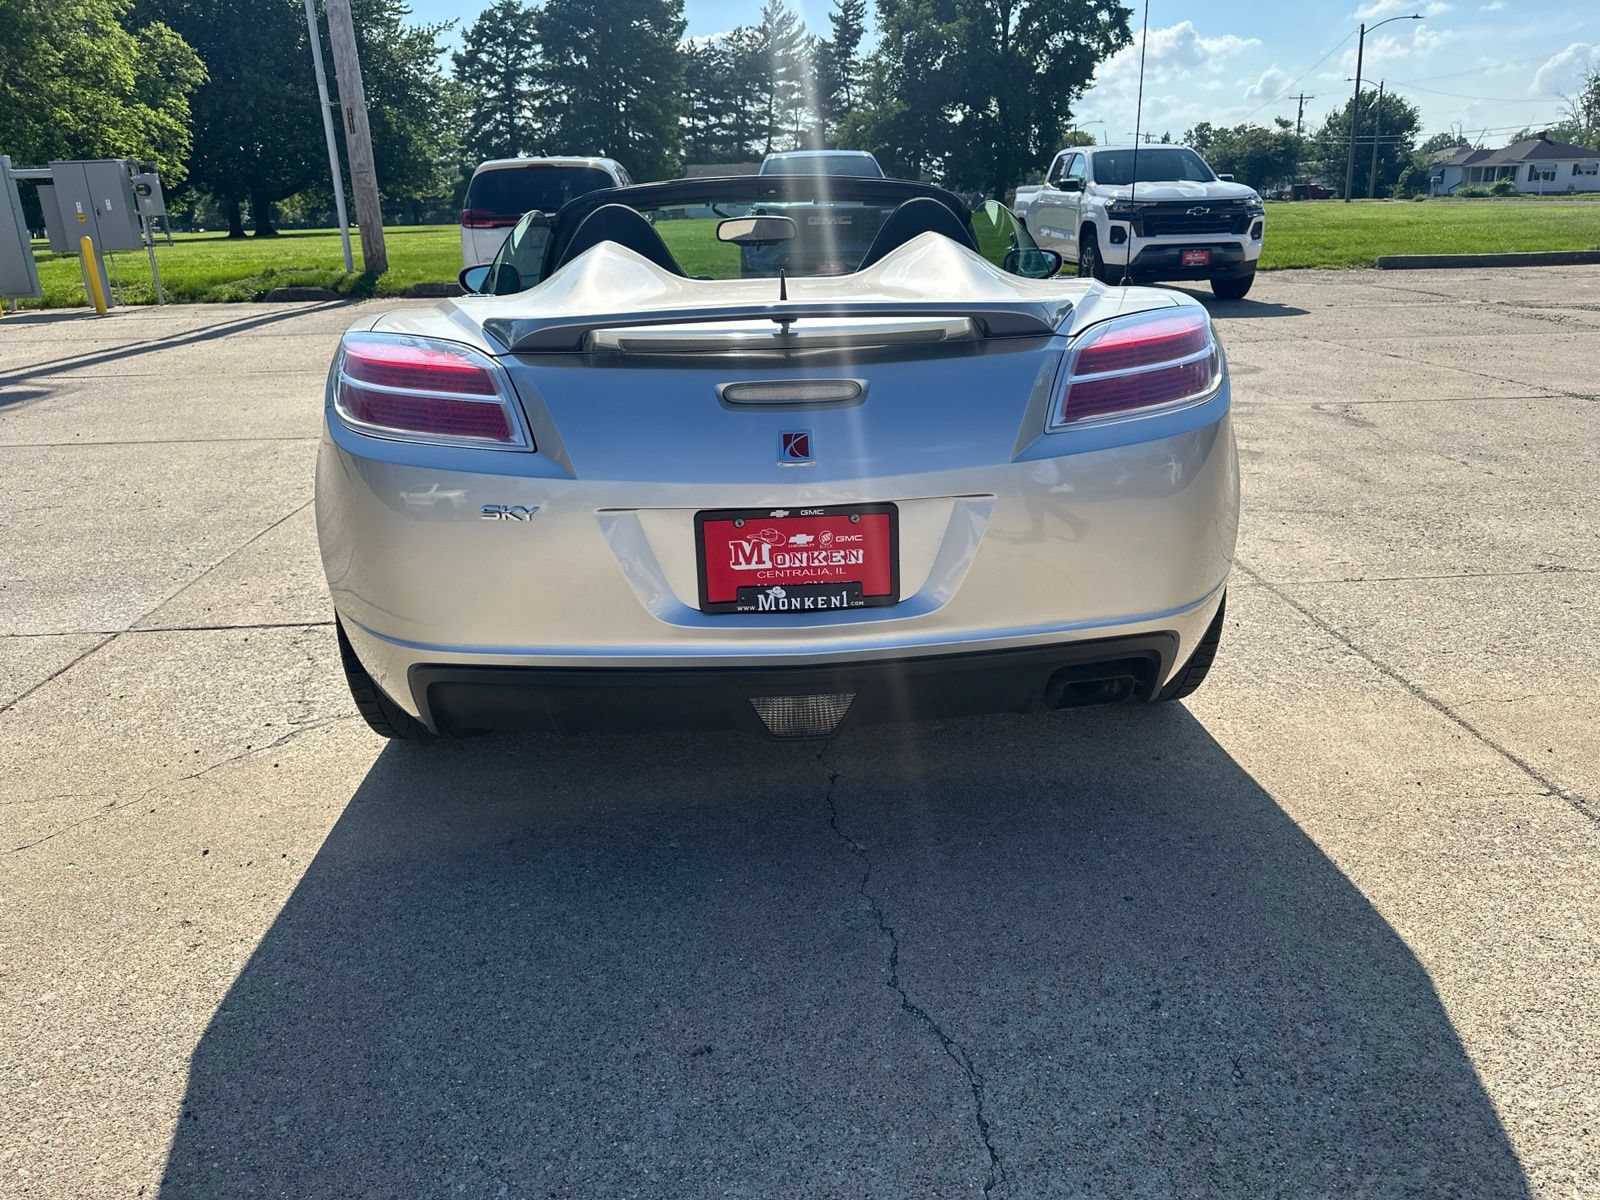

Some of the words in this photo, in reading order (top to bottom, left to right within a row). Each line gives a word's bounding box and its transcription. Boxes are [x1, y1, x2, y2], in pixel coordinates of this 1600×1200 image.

[480, 504, 540, 521] SKY
[835, 534, 863, 542] GMC
[757, 568, 833, 579] CENTRALIA,
[835, 567, 847, 575] IL
